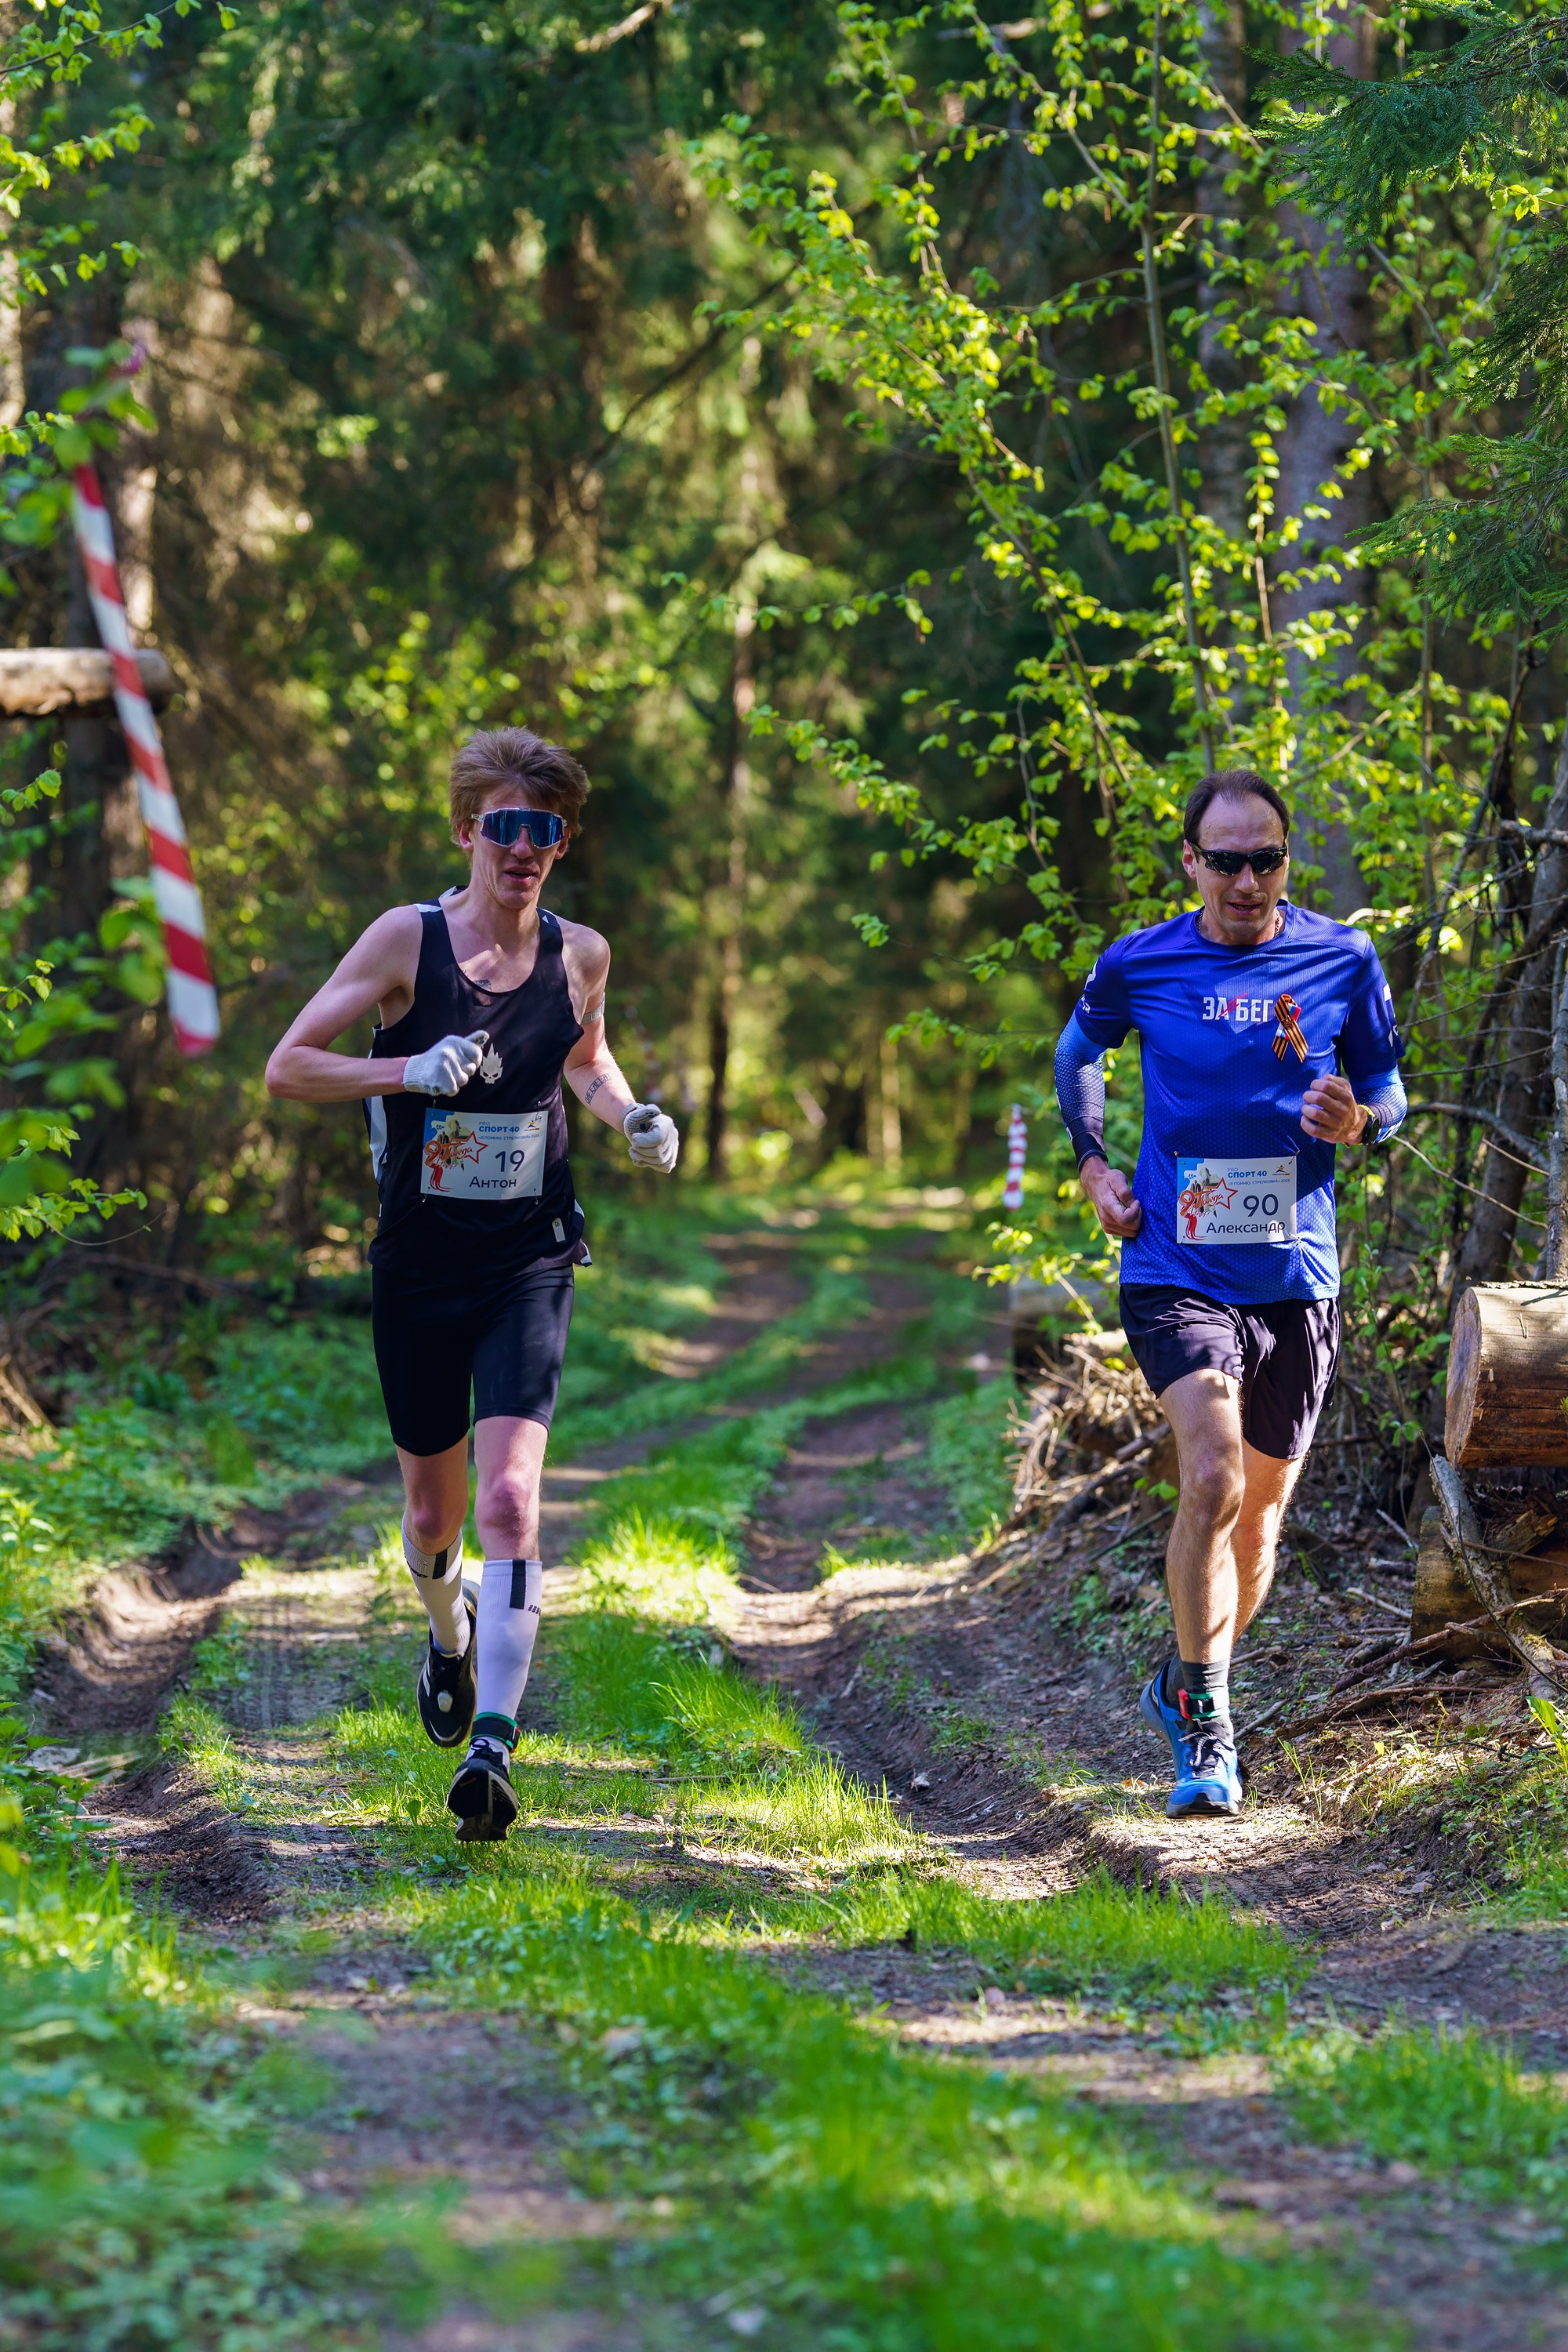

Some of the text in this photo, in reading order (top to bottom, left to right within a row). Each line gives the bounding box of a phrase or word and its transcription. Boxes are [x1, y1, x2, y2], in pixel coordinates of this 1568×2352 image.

[495, 1149, 525, 1173] 19
[468, 1176, 517, 1189] Антон
[1243, 1193, 1279, 1218] 90
[1206, 1221, 1286, 1234] Александр
